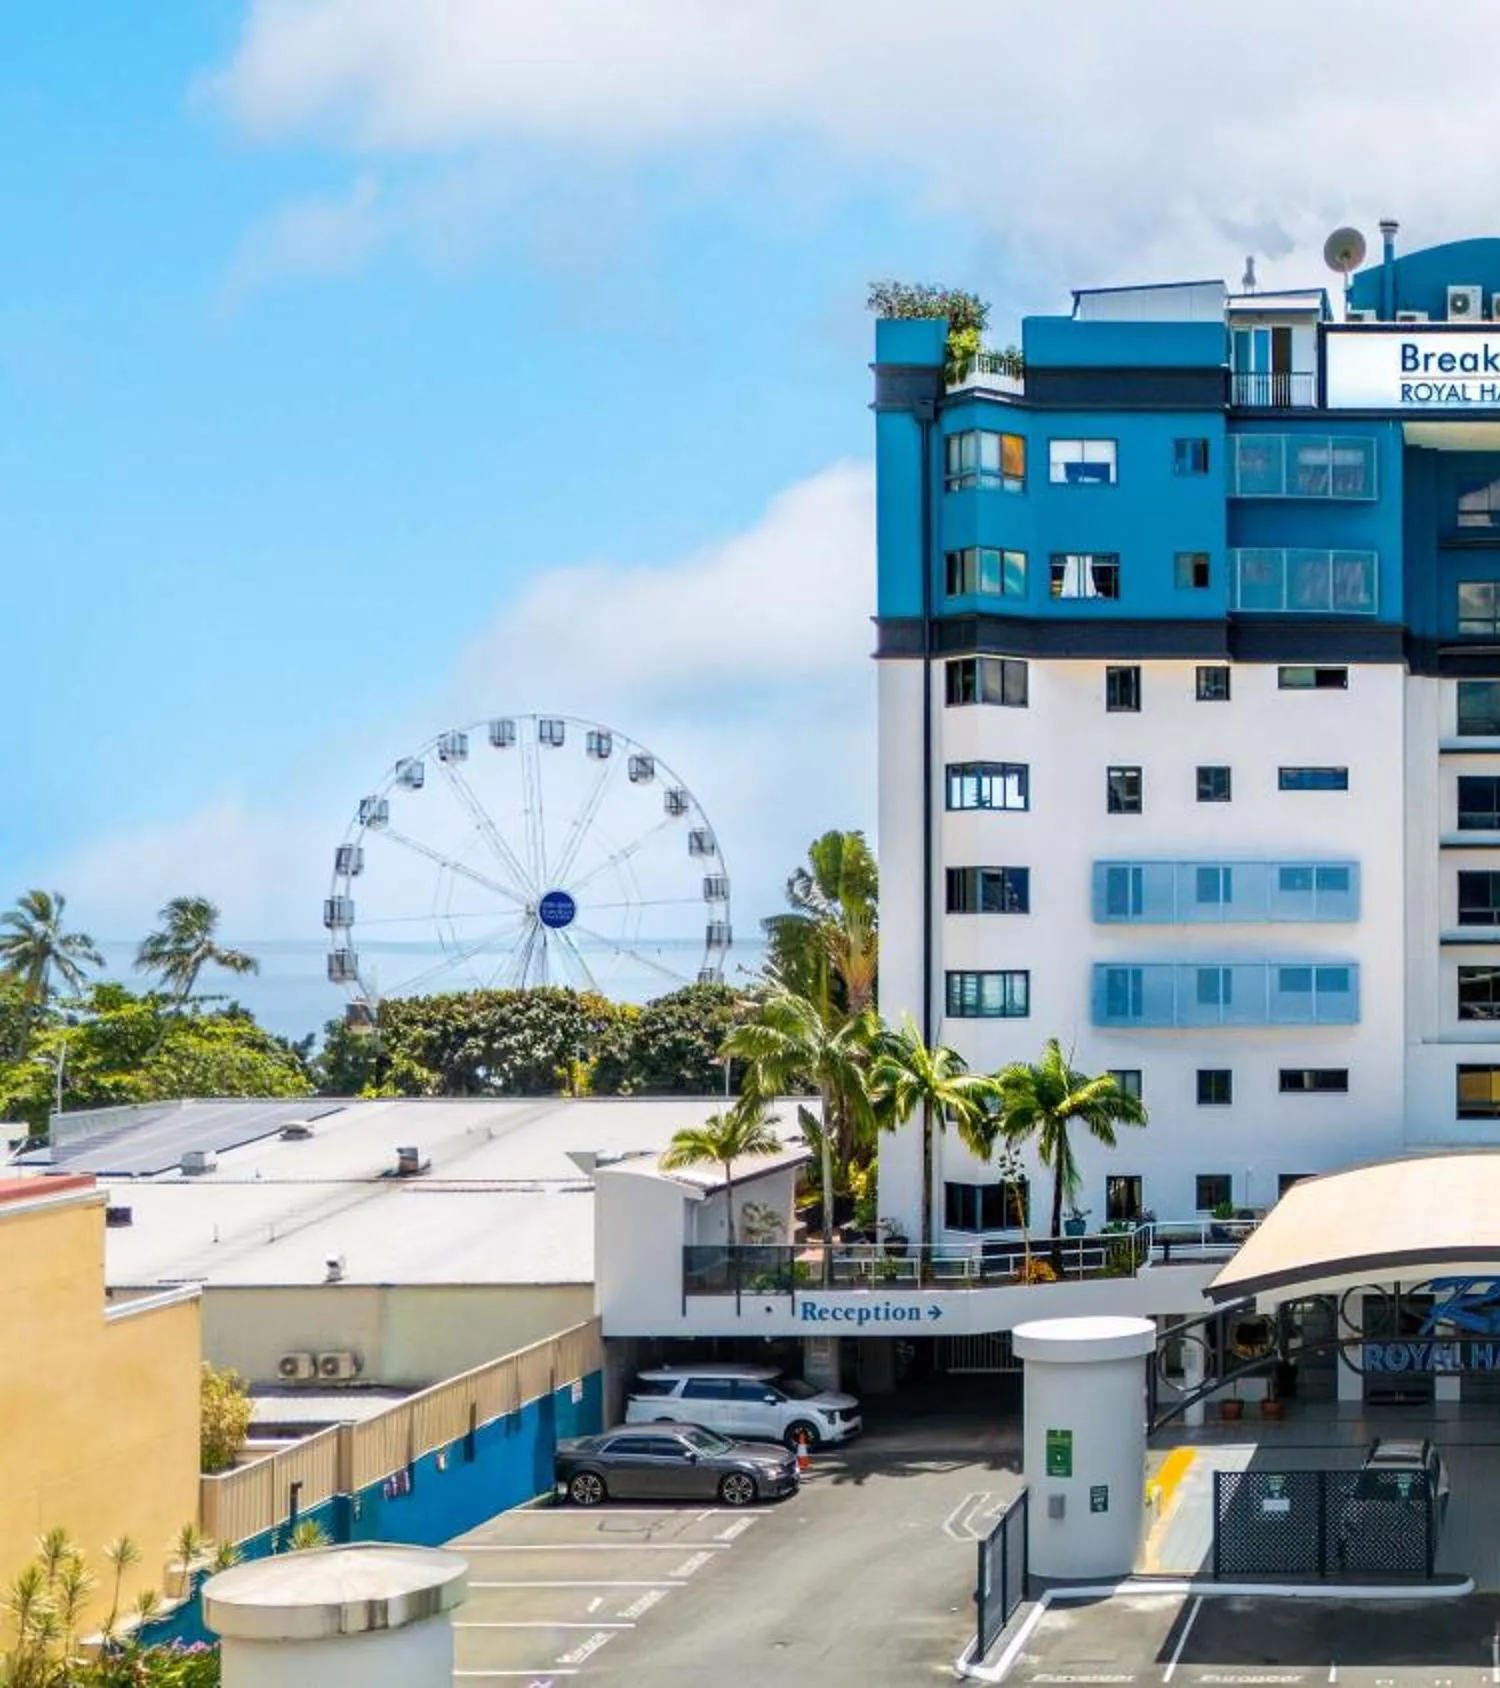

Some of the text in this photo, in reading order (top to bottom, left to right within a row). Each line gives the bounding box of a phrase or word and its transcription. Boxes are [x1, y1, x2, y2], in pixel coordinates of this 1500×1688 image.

[1401, 383, 1471, 402] ROYAL
[800, 1301, 921, 1326] Reception
[1364, 1343, 1464, 1372] ROYAL
